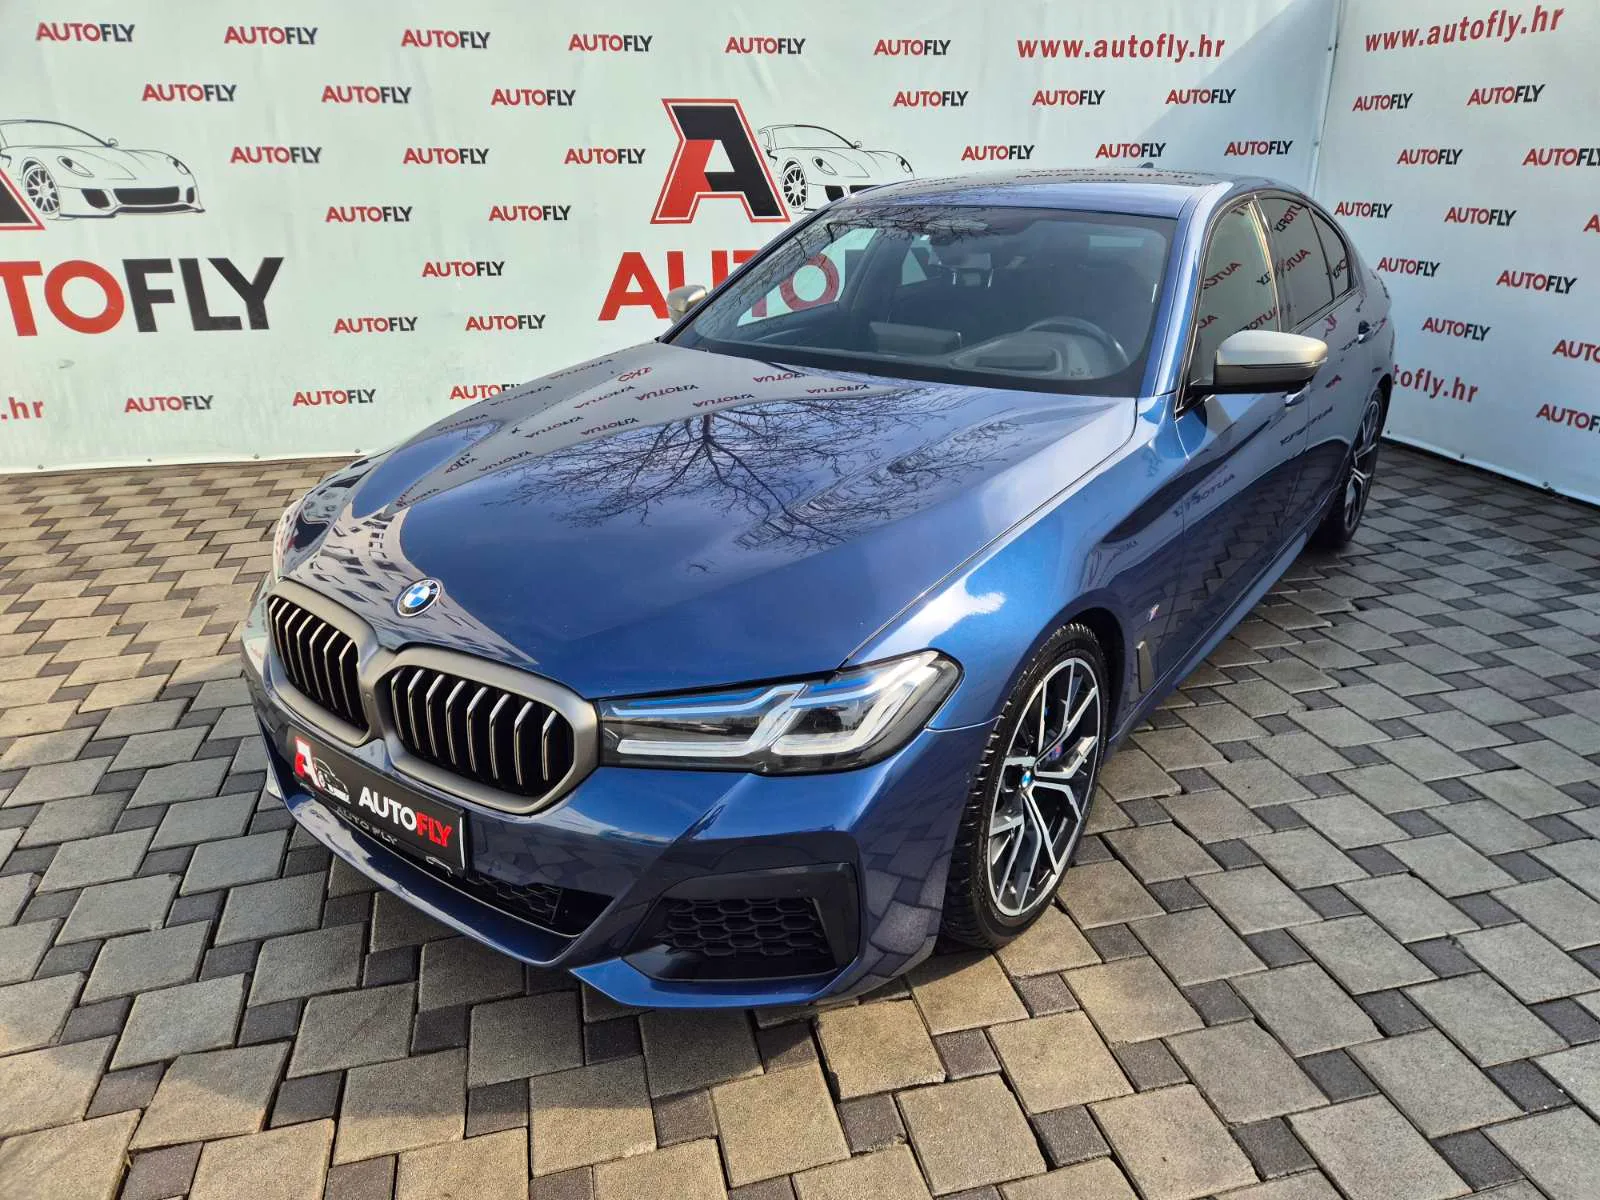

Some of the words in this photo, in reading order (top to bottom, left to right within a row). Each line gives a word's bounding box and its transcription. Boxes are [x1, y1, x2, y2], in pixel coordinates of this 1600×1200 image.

[35, 22, 136, 43] AUTOFLY
[223, 25, 319, 46] AUTOFLY
[1365, 4, 1565, 53] www.autofly.hr
[400, 28, 491, 50] AUTOFLY
[567, 33, 654, 53] AUTOFLY
[724, 36, 807, 55] AUTOFLY
[873, 39, 952, 56] AUTOFLY
[1016, 32, 1226, 64] www.autofly.hr
[141, 83, 238, 103] AUTOFLY
[320, 85, 413, 105] AUTOFLY
[490, 88, 577, 107] AUTOFLY
[892, 90, 969, 108] AUTOFLY
[1031, 89, 1106, 107] AUTOFLY
[1164, 88, 1237, 105] AUTOFLY
[1351, 92, 1414, 112] AUTOFLY
[1466, 83, 1546, 106] AUTOFLY
[229, 146, 323, 164] AUTOFLY
[402, 147, 490, 165] AUTOFLY
[563, 147, 647, 165] AUTOFLY
[960, 144, 1036, 162] AUTOFLY
[1095, 142, 1167, 159] AUTOFLY
[1223, 139, 1294, 157] AUTOFLY
[1396, 148, 1464, 166] AUTOFLY
[324, 205, 414, 223] AUTOFLY
[488, 204, 572, 222] AUTOFLY
[1334, 201, 1393, 220] AUTOFLY
[1443, 206, 1518, 227] AUTOFLY
[421, 260, 506, 278] AUTOFLY
[1376, 257, 1441, 278] AUTOFLY
[1495, 269, 1578, 295] AUTOFLY
[333, 315, 419, 335] AUTOFLY
[464, 313, 547, 332] AUTOFLY
[1421, 316, 1492, 342] AUTOFLY
[124, 394, 214, 413] AUTOFLY
[292, 388, 377, 407] AUTOFLY
[358, 785, 453, 848] AUTOFLY
